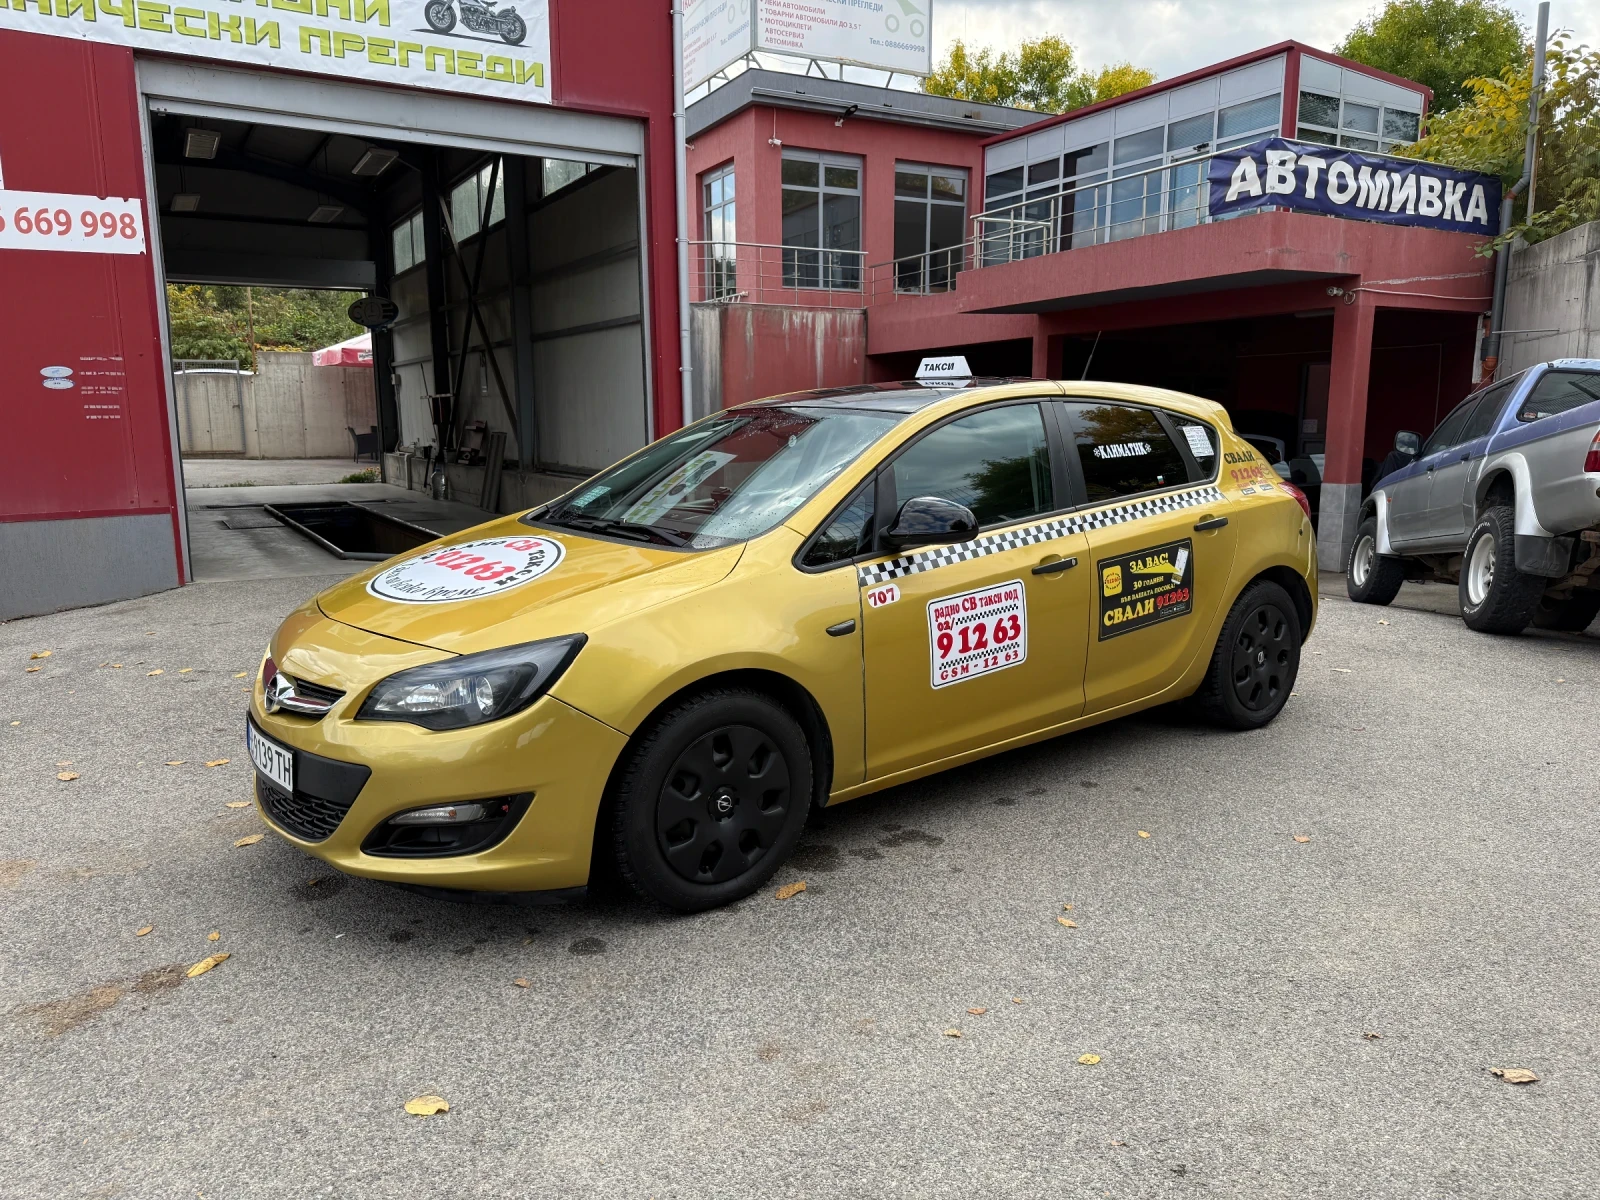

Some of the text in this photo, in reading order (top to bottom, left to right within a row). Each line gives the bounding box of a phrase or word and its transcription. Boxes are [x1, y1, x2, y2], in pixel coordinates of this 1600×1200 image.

[782, 1, 826, 15] АВТОМОБИЛИ
[764, 7, 795, 18] ТОВАРНИ
[795, 13, 838, 26] АВТОМОБИЛИ
[838, 20, 848, 28] ДО
[848, 22, 858, 30] 3,5
[764, 17, 813, 32] МОТОЦИКЛЕТИ
[764, 27, 805, 40] АВТОСЕРВИЗ
[764, 36, 804, 49] АВТОМИВКА
[884, 39, 926, 53] 0886669998
[299, 25, 544, 88] ПРЕГЛЕДИ
[1225, 149, 1489, 226] АВТОМИВКА
[80, 210, 138, 240] 998
[924, 362, 955, 372] ТАКСИ
[1129, 552, 1169, 573] ЗА ВАС!
[1133, 580, 1142, 591] 30
[868, 588, 895, 607] 707
[934, 604, 960, 622] радио
[962, 596, 978, 613] СВ
[979, 593, 1003, 608] такси
[1103, 598, 1155, 626] СВАЛИ
[1156, 587, 1190, 610] 91263
[993, 614, 1022, 645] 63
